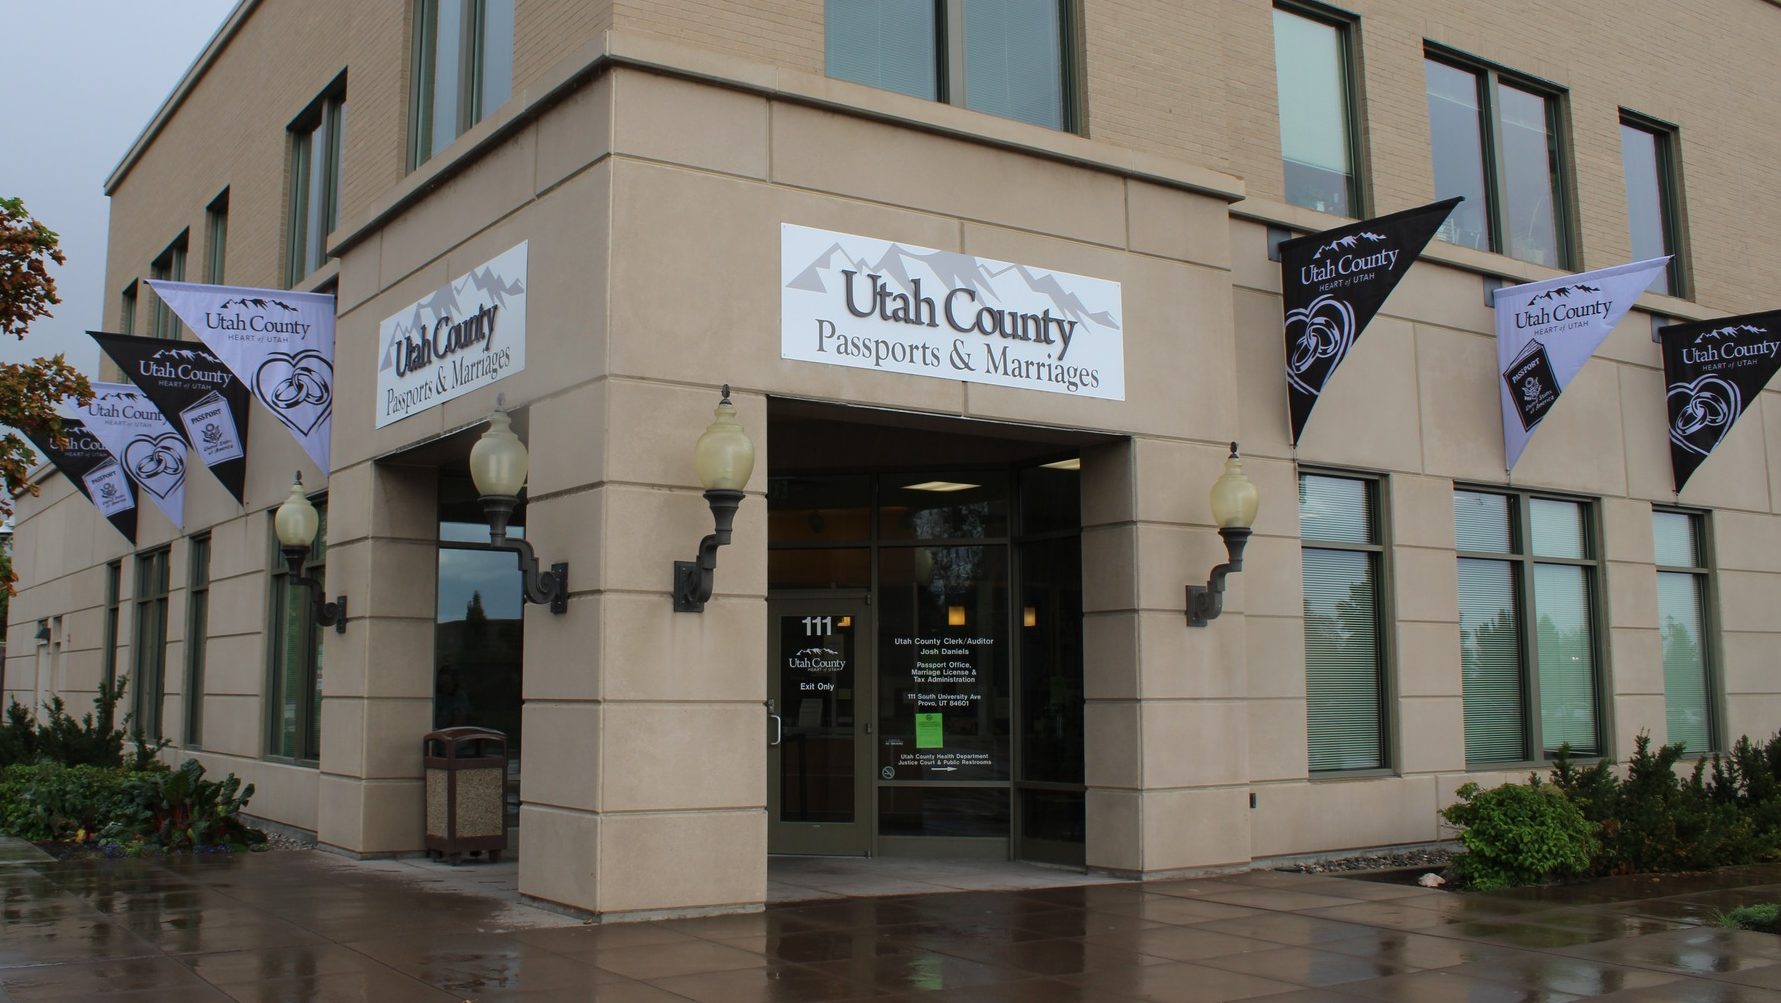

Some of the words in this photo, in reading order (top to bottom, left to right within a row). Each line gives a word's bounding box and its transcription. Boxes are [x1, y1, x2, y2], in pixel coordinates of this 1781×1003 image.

[1301, 259, 1336, 285] Utah
[1338, 249, 1399, 275] County
[1319, 280, 1343, 292] HEART
[1344, 278, 1351, 287] of
[1353, 272, 1375, 283] UTAH
[841, 269, 939, 328] Utah
[945, 287, 1078, 361] County
[1515, 307, 1550, 329] Utah
[1553, 300, 1613, 322] County
[205, 312, 246, 331] Utah
[249, 315, 311, 340] County
[1534, 326, 1558, 336] HEART
[1559, 324, 1566, 334] of
[1568, 321, 1589, 330] UTAH
[395, 323, 432, 378] Utah
[433, 303, 498, 359] County
[815, 318, 941, 368] Passports
[949, 339, 976, 372] &
[984, 343, 1099, 392] Marriages
[1682, 344, 1719, 364] Utah
[1721, 340, 1781, 358] County
[139, 360, 176, 378] Utah
[178, 364, 233, 388] County
[1511, 357, 1540, 384] PASSPORT
[1702, 362, 1726, 371] HEART
[1728, 361, 1735, 370] of
[1737, 359, 1758, 367] UTAH
[192, 382, 212, 390] UTAH
[387, 378, 433, 416] Passports
[435, 365, 447, 394] &
[451, 346, 510, 389] Marriages
[88, 403, 120, 418] Utah
[191, 408, 222, 425] PASSPORT
[802, 616, 832, 636] 111
[914, 638, 941, 646] County
[943, 637, 994, 645] Clerk/Auditor
[788, 657, 811, 668] Utah
[812, 657, 846, 671] County
[916, 661, 946, 669] Passport
[800, 683, 815, 691] Exit
[817, 683, 834, 692] Only
[937, 693, 968, 701] University
